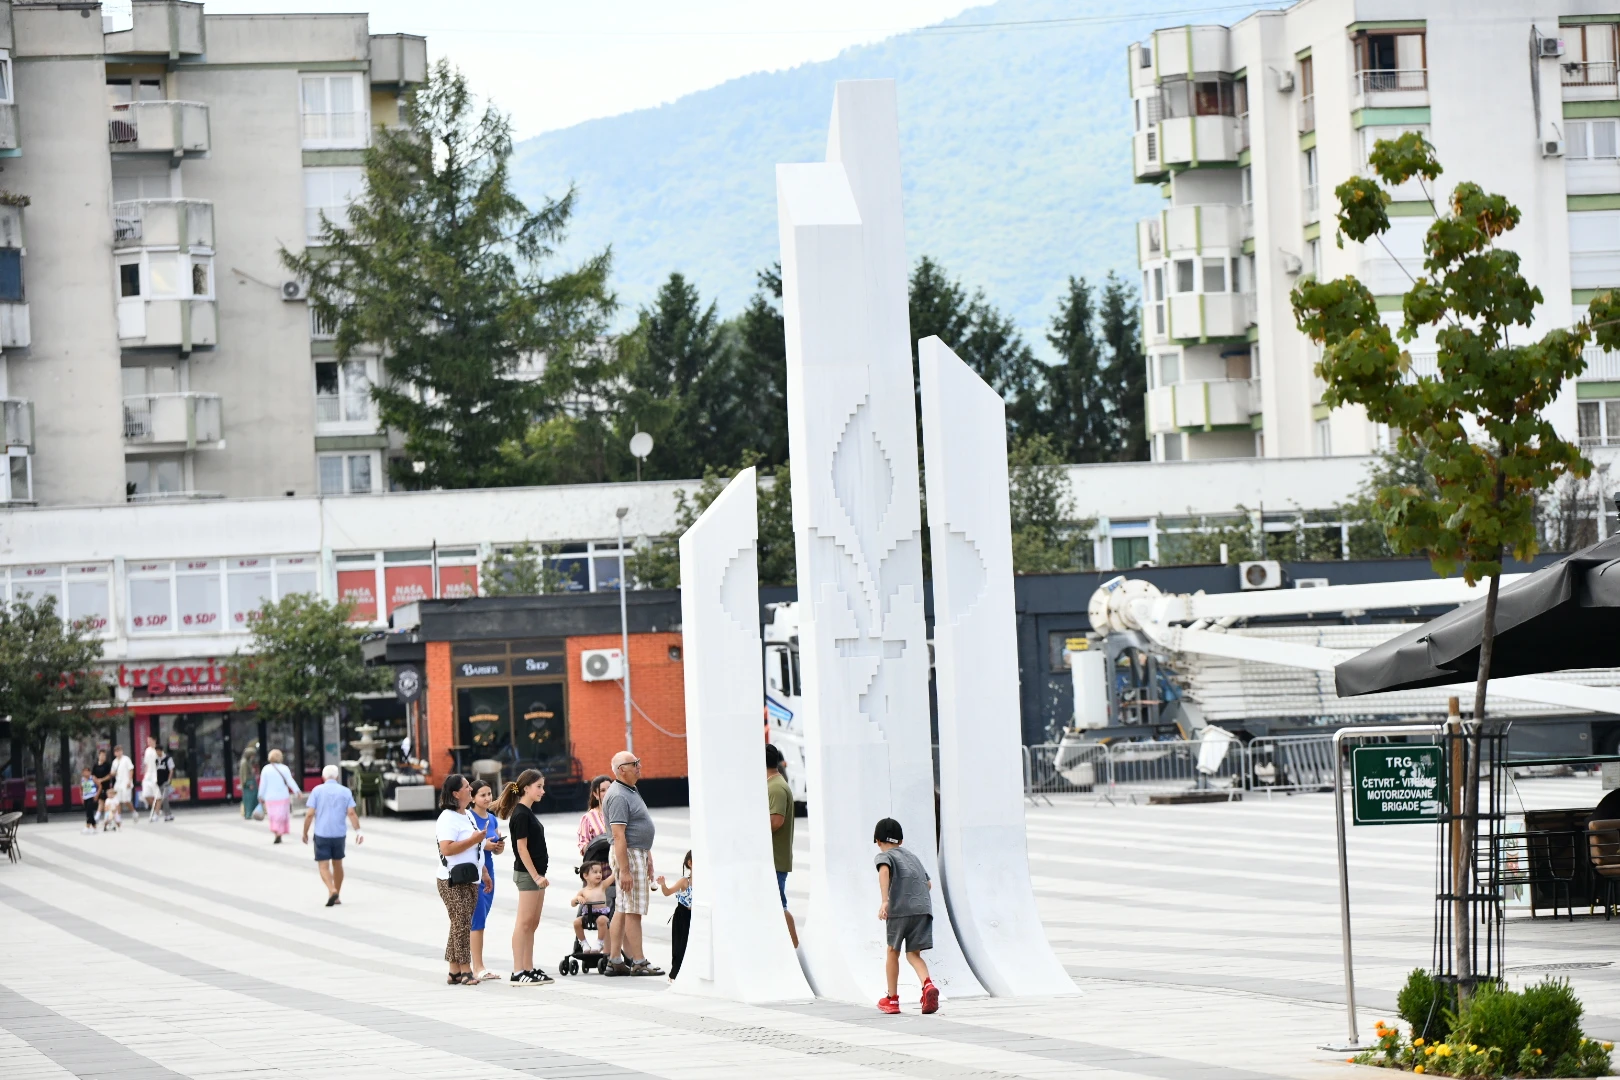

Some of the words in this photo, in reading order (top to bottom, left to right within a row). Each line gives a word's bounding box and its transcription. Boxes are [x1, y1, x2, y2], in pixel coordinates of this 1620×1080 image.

[146, 614, 167, 626] SDP
[196, 613, 216, 624] SDP
[168, 685, 197, 693] World
[1386, 757, 1412, 768] TRG
[1362, 776, 1395, 788] ČETVRT
[1367, 789, 1433, 800] MOTORIZOVANE
[1382, 801, 1420, 811] BRIGADE
